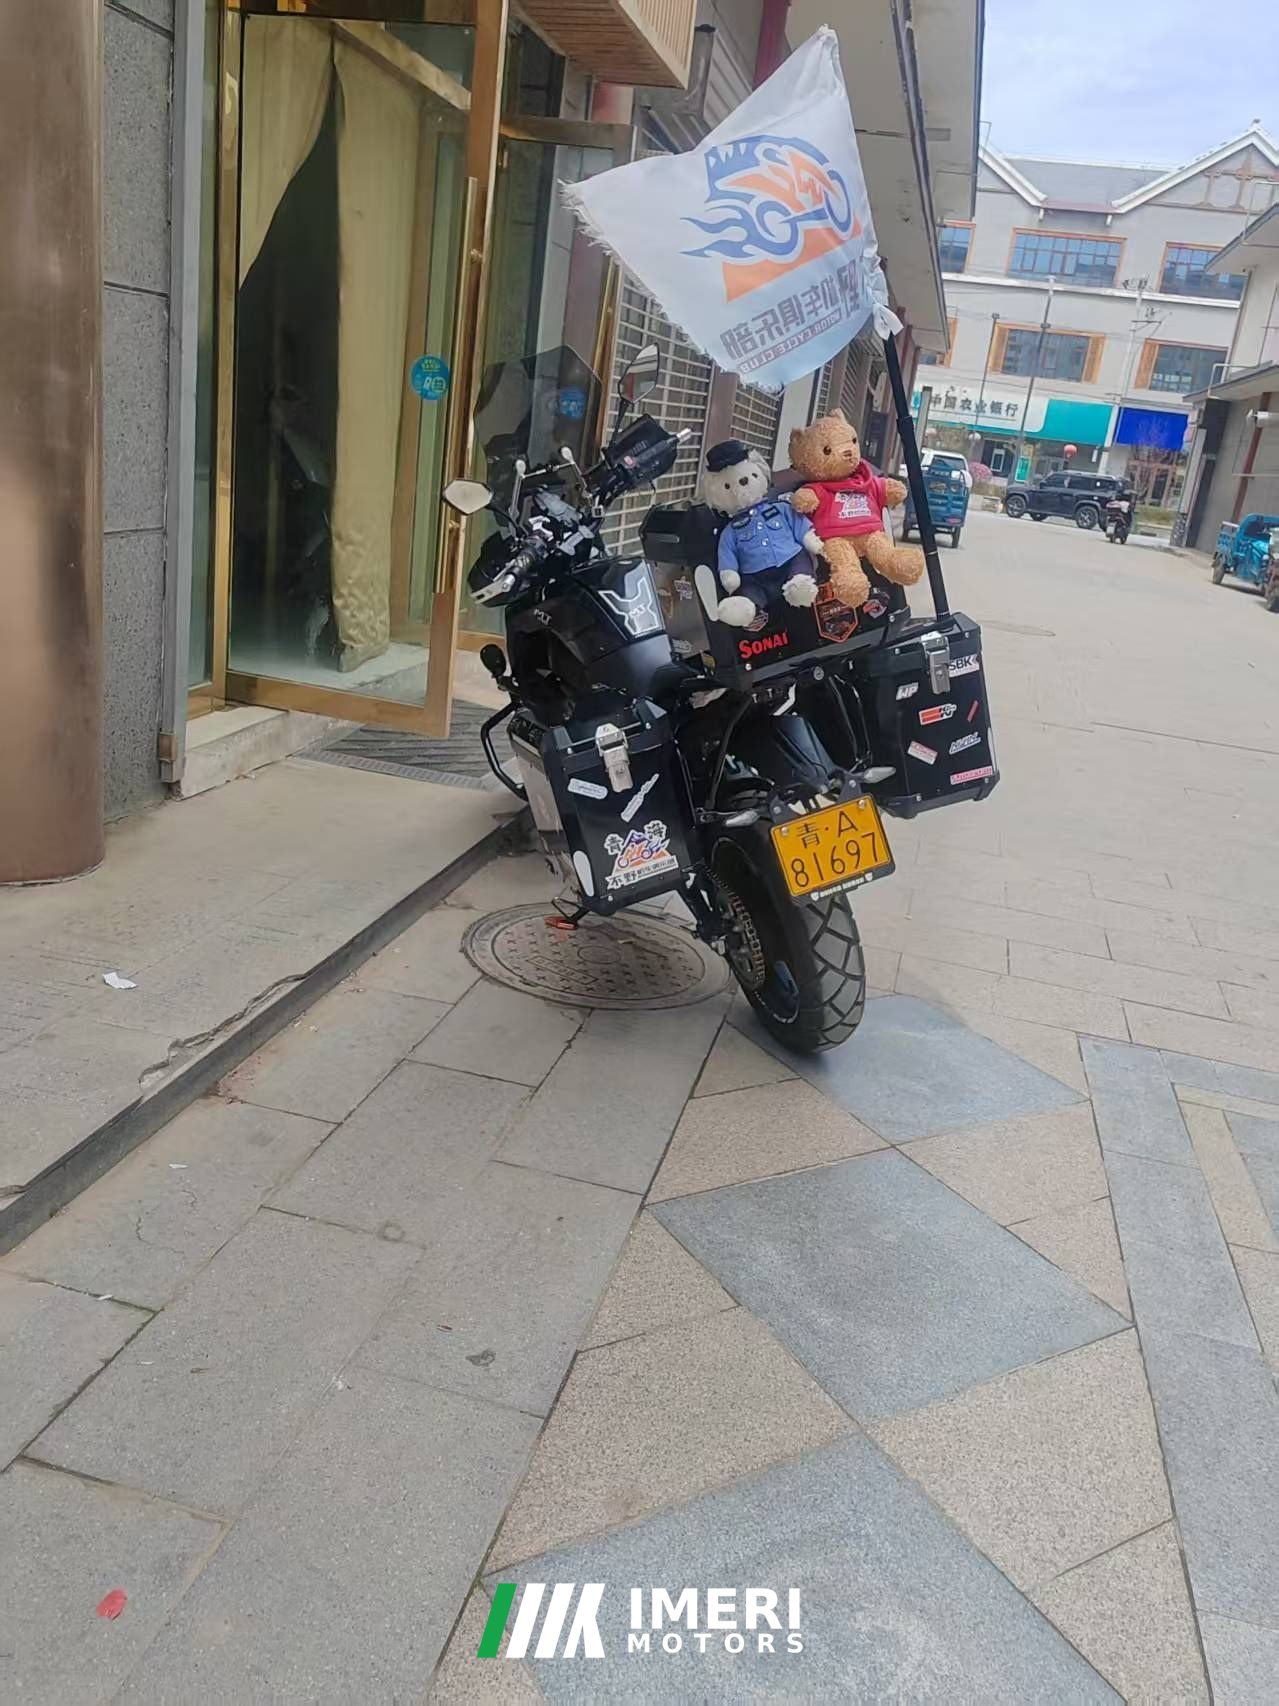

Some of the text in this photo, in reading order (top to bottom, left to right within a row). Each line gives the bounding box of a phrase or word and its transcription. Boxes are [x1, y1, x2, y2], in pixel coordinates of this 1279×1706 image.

[931, 393, 1018, 417] 中国农业银行
[949, 656, 971, 671] SBK
[791, 831, 878, 888] 81697
